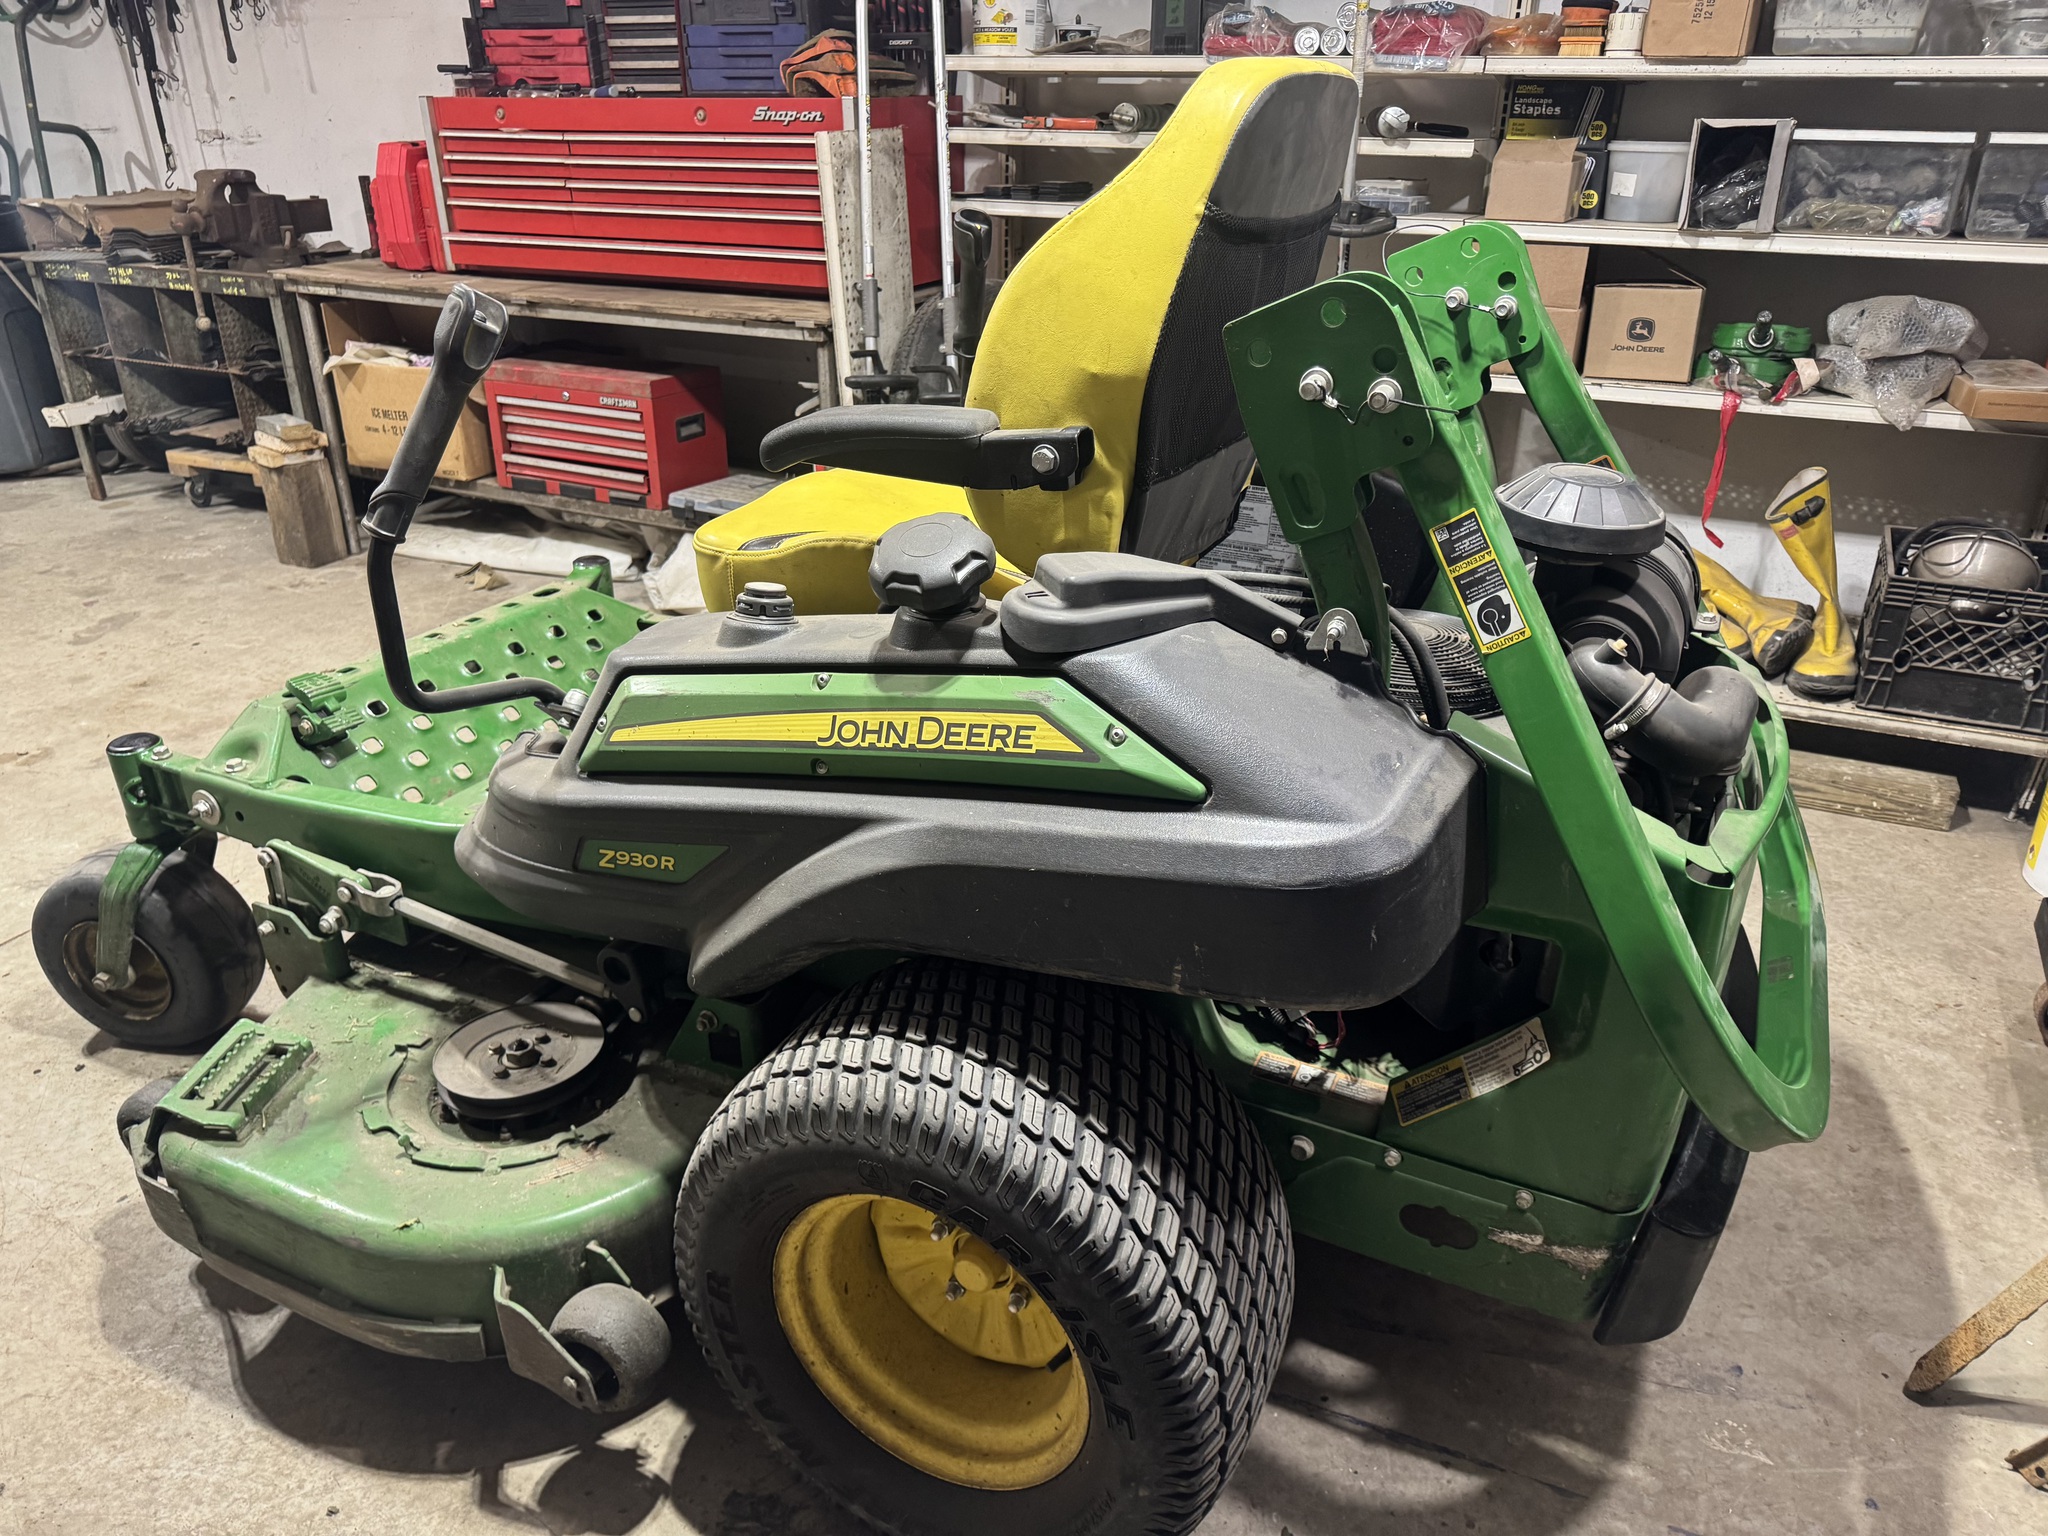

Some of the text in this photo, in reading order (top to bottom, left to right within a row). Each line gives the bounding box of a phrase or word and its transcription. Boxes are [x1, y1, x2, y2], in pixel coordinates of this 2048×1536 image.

[1691, 0, 1704, 24] 7525
[1514, 97, 1553, 105] Landscape
[1513, 104, 1561, 117] Staples
[1611, 344, 1665, 353] JOHN DEERE
[599, 397, 638, 409] CRAFTSMAN
[371, 407, 409, 421] ICE MELTER
[1448, 554, 1487, 576] ATENCIÓN
[1486, 633, 1520, 652] CAUTION
[817, 714, 1037, 752] JOHN DEERE
[597, 848, 676, 871] Z930R
